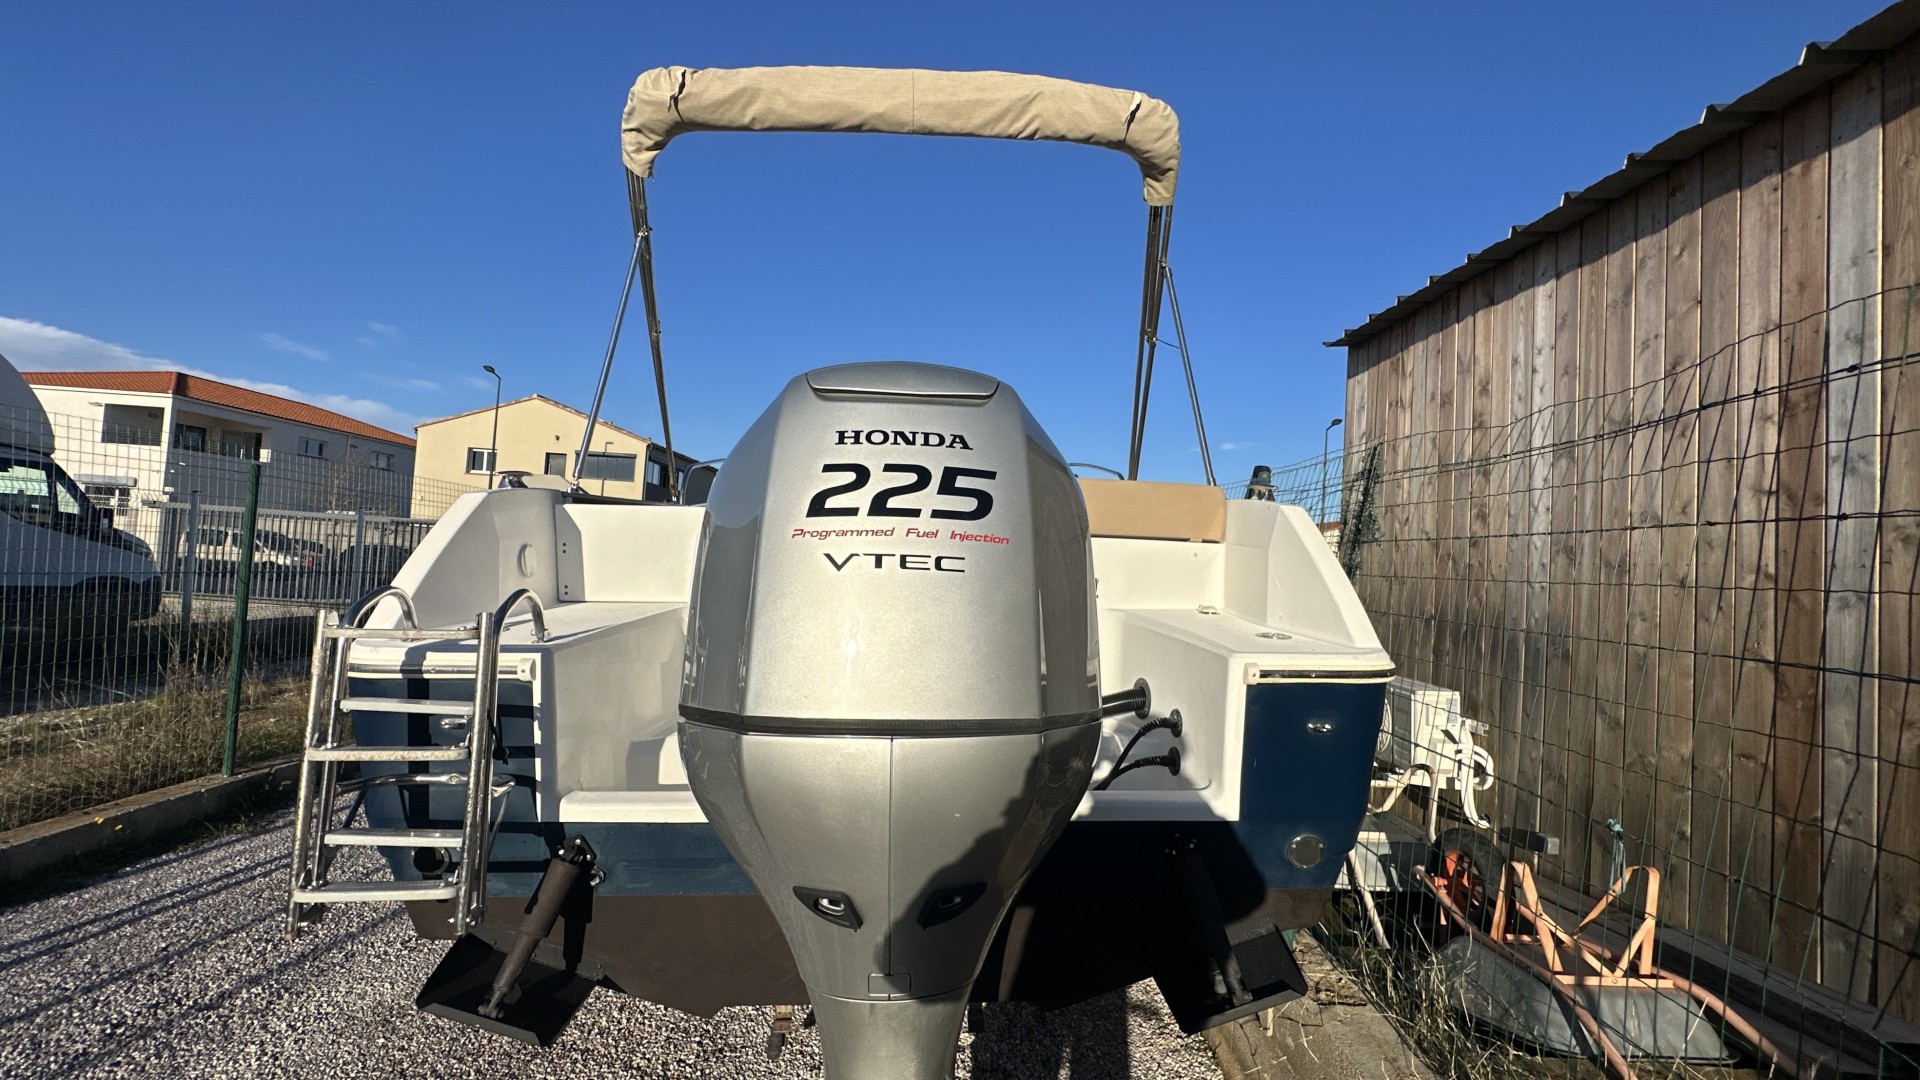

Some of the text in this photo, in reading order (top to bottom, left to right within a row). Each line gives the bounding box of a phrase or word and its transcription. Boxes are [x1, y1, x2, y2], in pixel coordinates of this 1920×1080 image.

[835, 429, 973, 450] HONDA
[806, 463, 997, 521] 225
[791, 527, 1010, 545] Programmed Fuel Injection
[823, 553, 965, 572] VTEC
